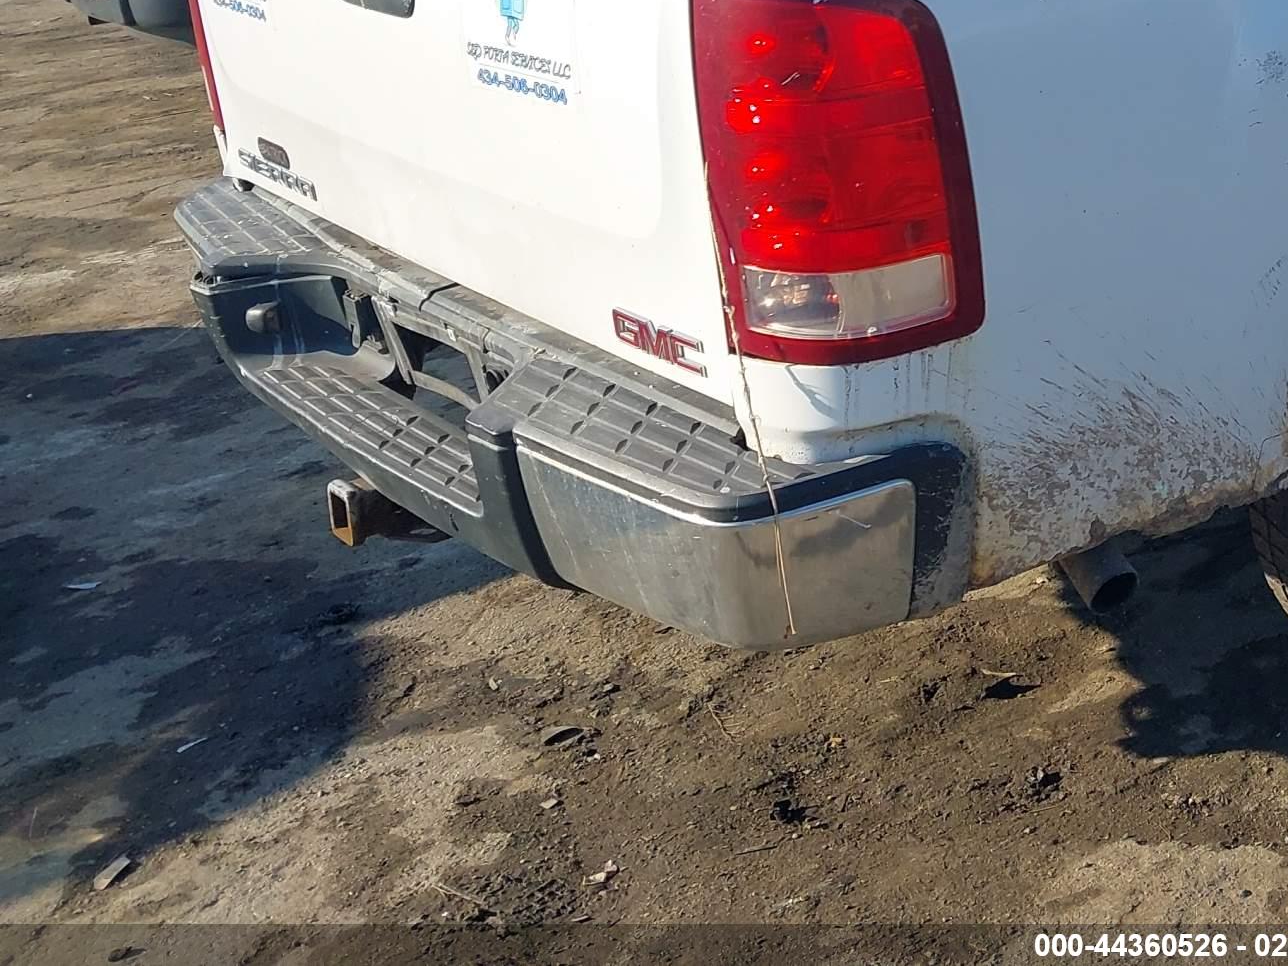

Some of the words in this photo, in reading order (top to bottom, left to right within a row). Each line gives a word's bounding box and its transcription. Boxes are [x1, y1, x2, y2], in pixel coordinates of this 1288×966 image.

[483, 45, 510, 65] PORTA
[510, 51, 552, 75] SERVICES
[552, 61, 572, 80] LLC
[477, 68, 568, 105] 434-506-0304
[238, 146, 318, 202] SIERRA
[612, 305, 708, 378] GMC
